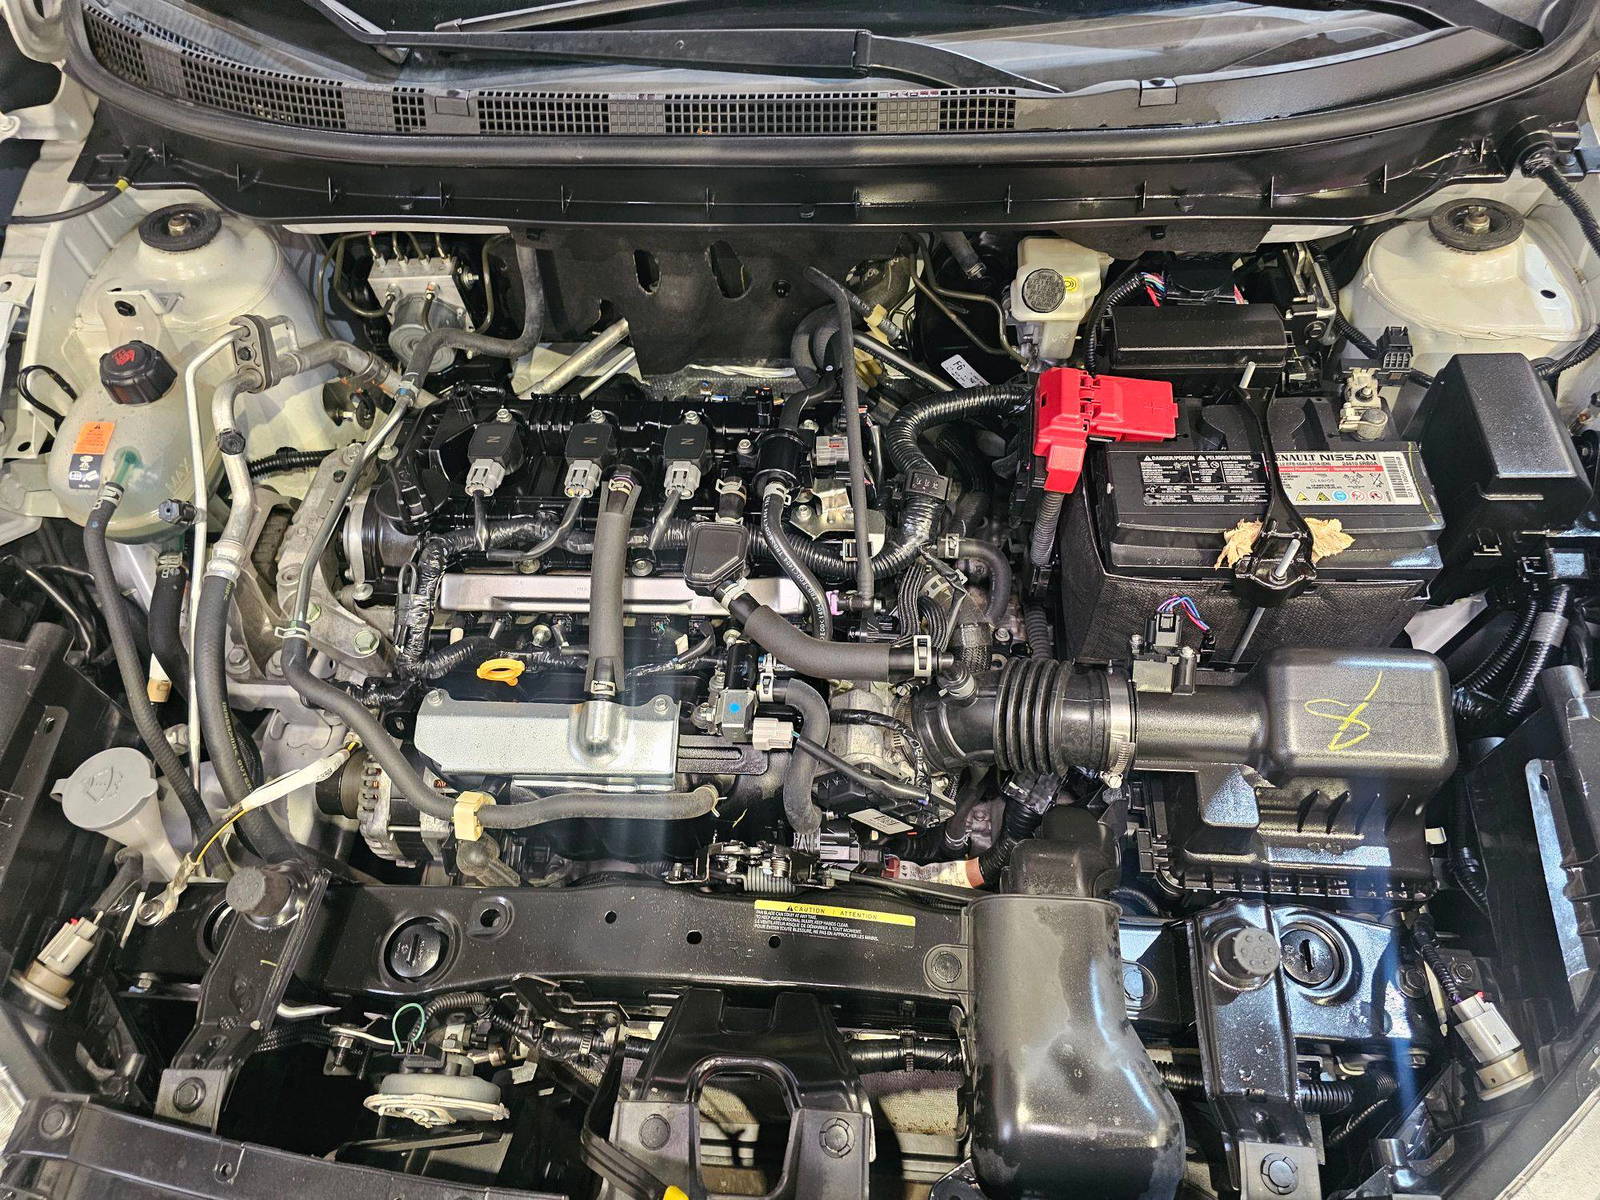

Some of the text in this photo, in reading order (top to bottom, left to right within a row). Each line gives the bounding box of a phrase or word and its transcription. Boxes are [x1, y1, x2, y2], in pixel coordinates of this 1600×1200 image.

[1276, 453, 1316, 461] ENAULT
[793, 905, 877, 919] CAUTION ATTENTION
